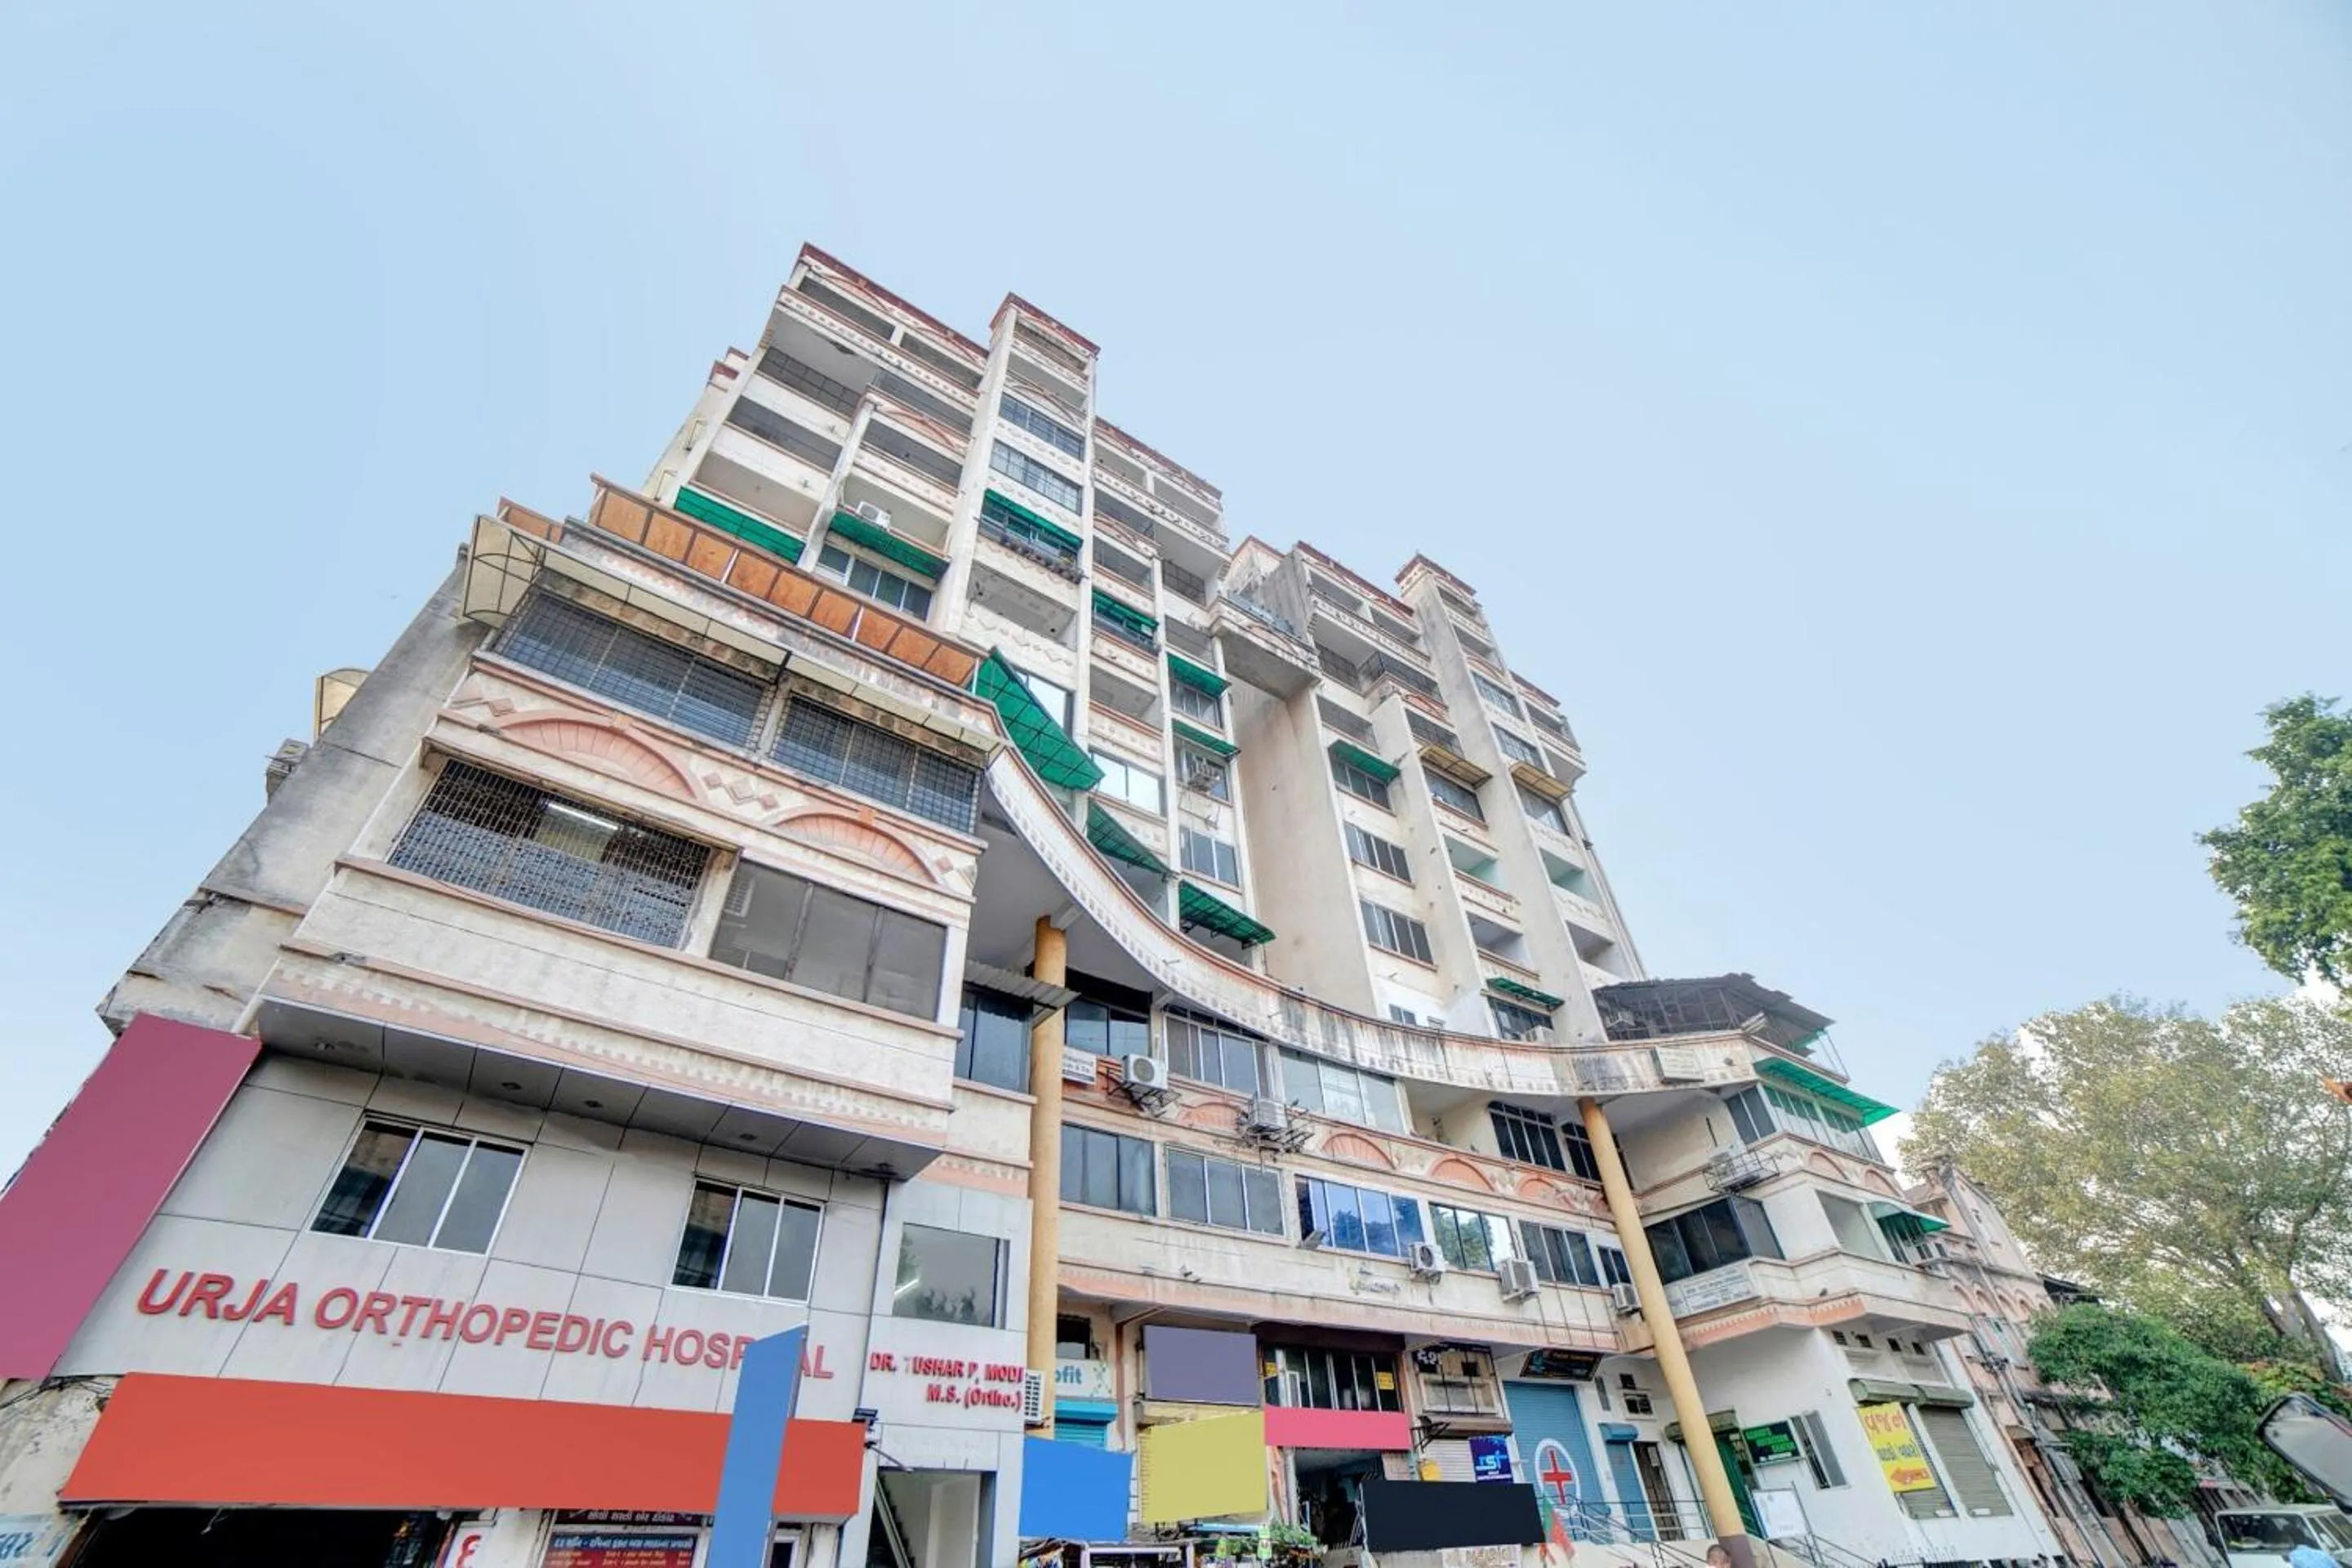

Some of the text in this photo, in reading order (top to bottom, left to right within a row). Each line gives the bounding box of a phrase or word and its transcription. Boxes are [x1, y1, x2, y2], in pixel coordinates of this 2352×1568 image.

[136, 1268, 298, 1326] URJA
[314, 1286, 634, 1359] ORTHOPEDIC
[870, 1352, 898, 1373] DR.
[984, 1363, 1024, 1383] MODI
[926, 1383, 1022, 1413] M.S. (Ortho.)
